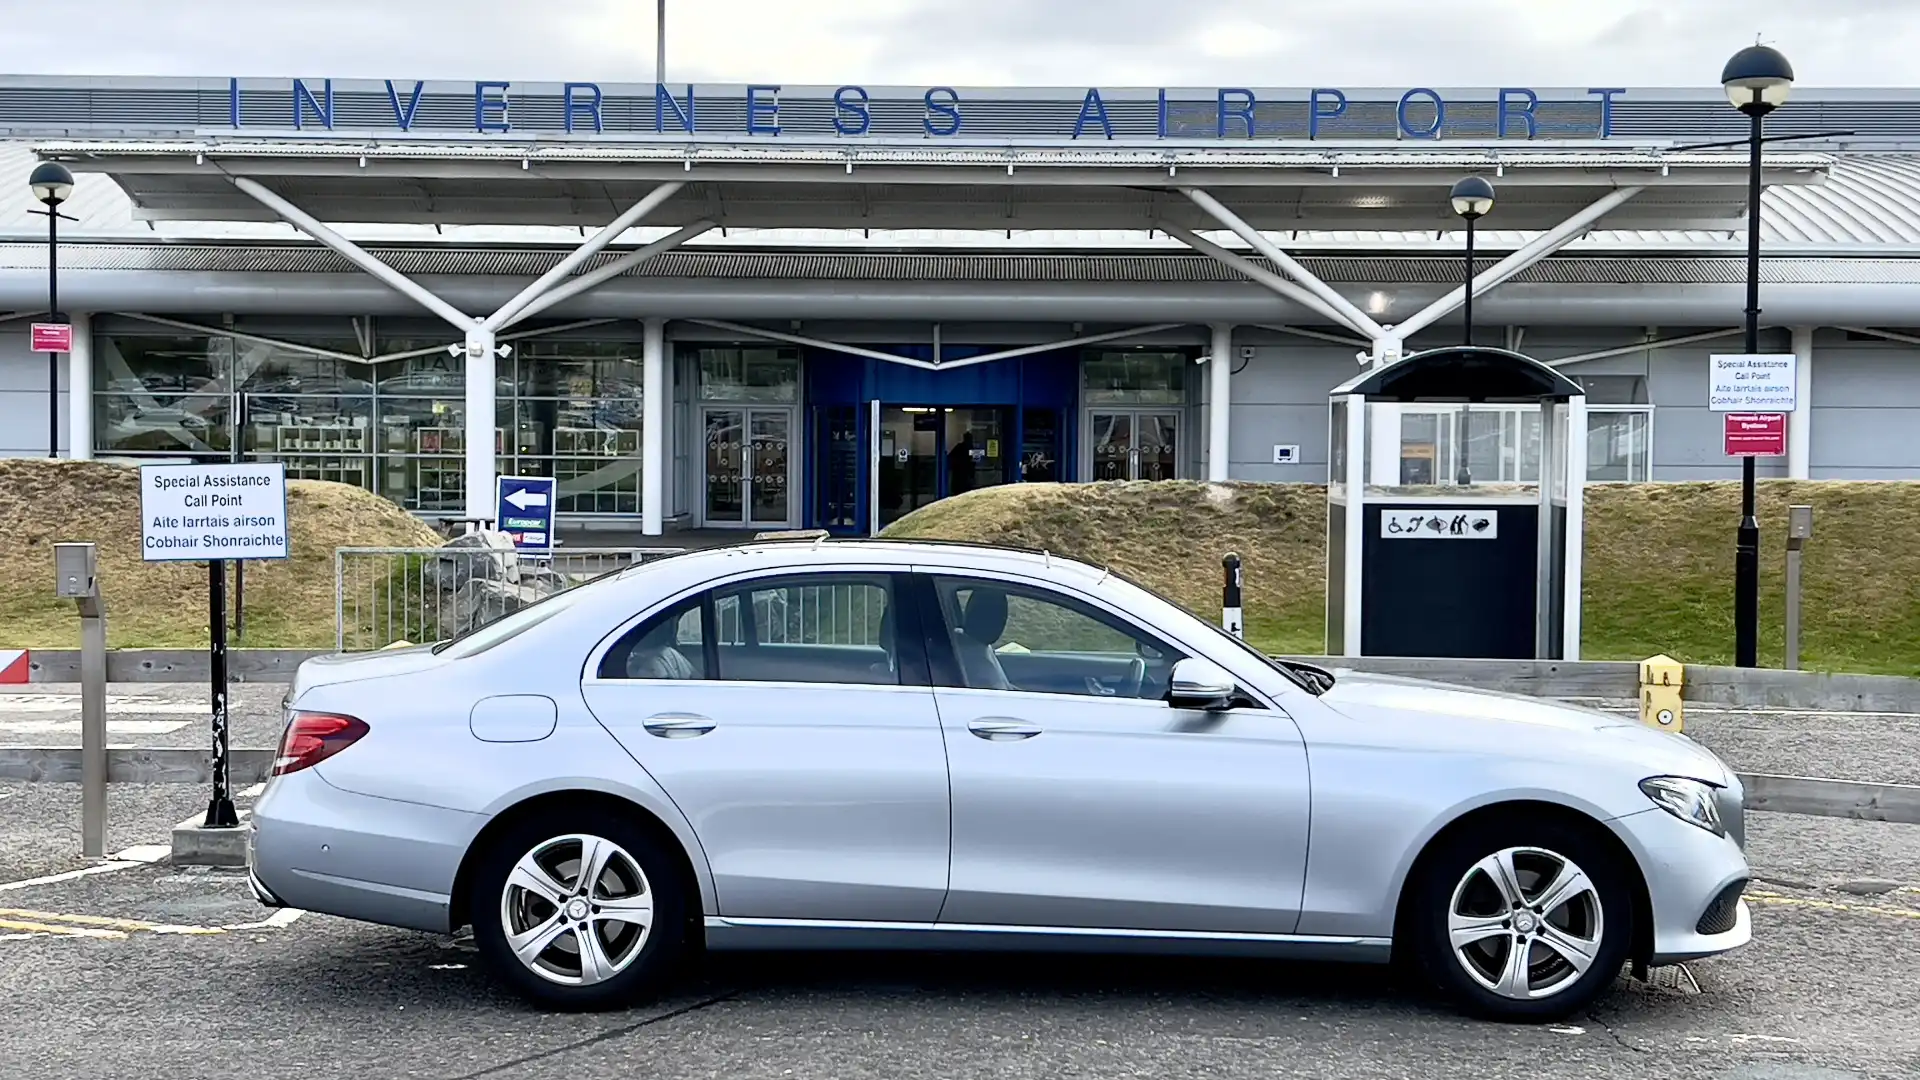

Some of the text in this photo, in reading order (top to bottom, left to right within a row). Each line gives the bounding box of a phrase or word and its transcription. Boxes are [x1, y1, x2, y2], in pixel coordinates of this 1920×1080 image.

[231, 77, 1627, 140] INVERNESS AIRPORT
[1717, 360, 1788, 370] Special Assistance
[1735, 372, 1771, 380] Call Point
[154, 474, 271, 491] Special Assistance
[184, 494, 243, 507] Call Point
[153, 516, 179, 528] Aite
[233, 514, 275, 527] airson
[145, 534, 284, 549] Cobhair Shonraichte
